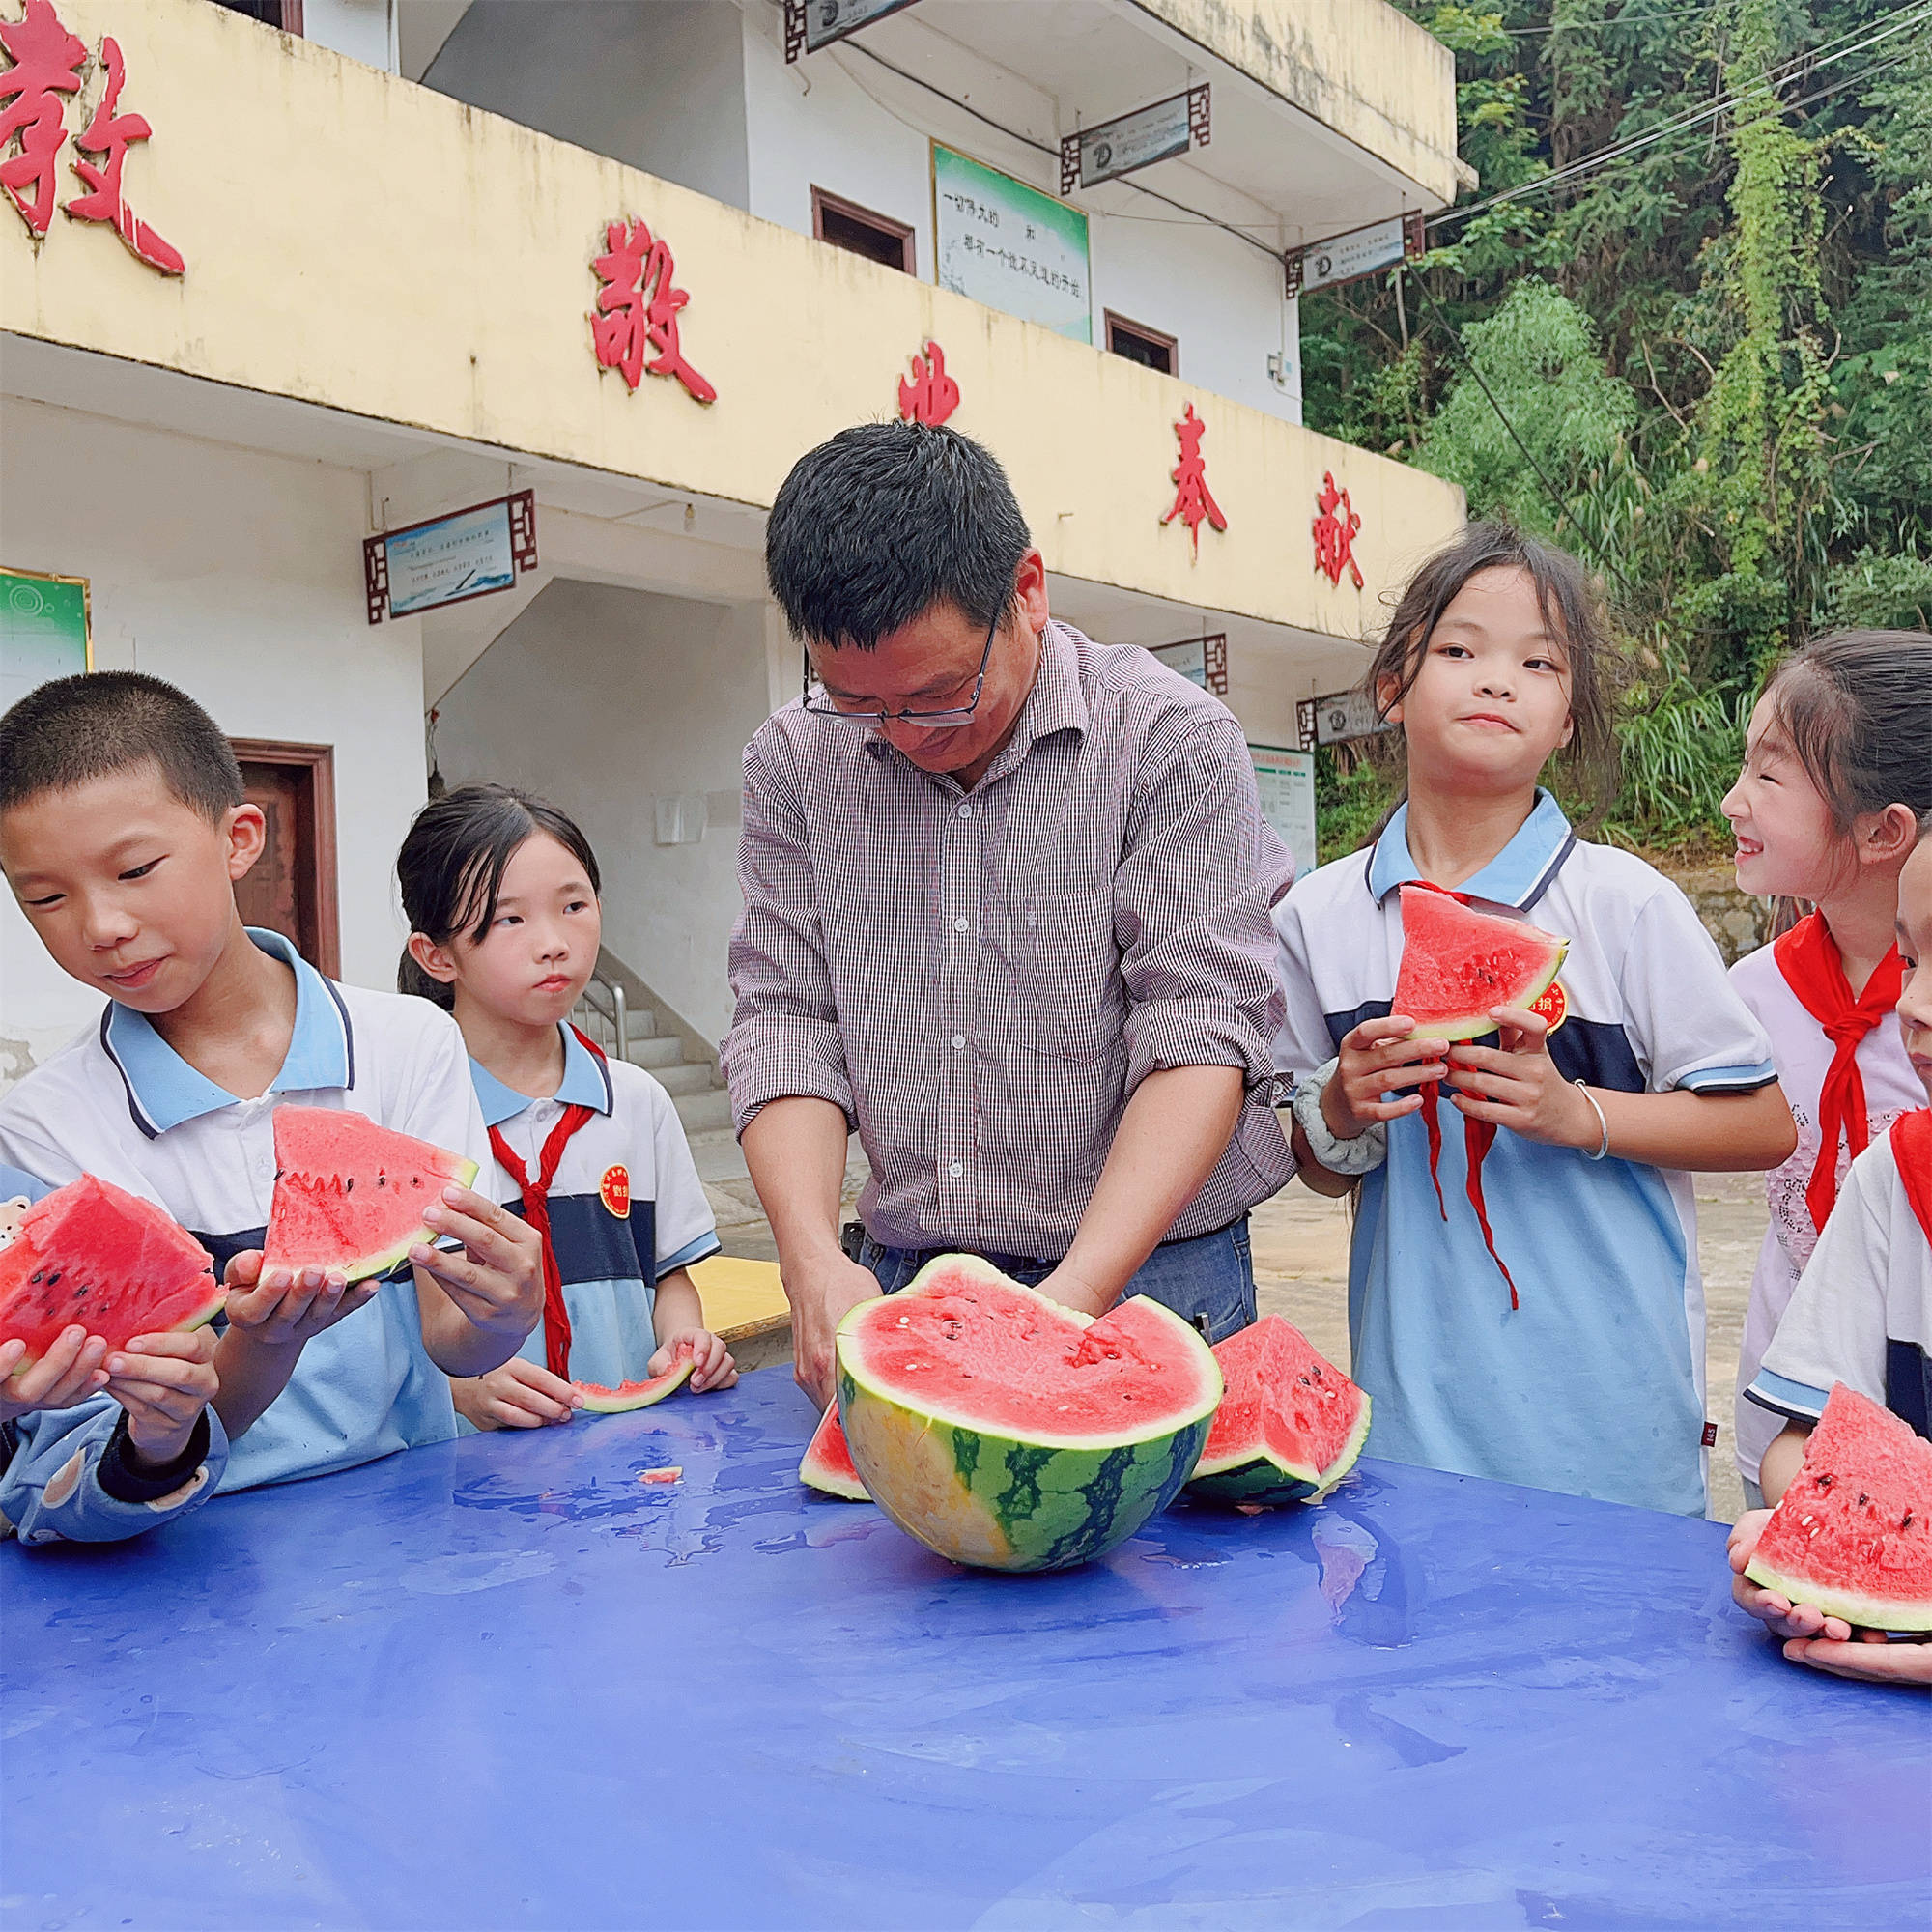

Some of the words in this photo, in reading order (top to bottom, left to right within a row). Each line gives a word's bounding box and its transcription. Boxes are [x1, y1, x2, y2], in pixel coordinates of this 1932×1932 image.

[587, 216, 718, 404] 敬
[1160, 400, 1229, 564] 奉
[1312, 469, 1365, 589] 献
